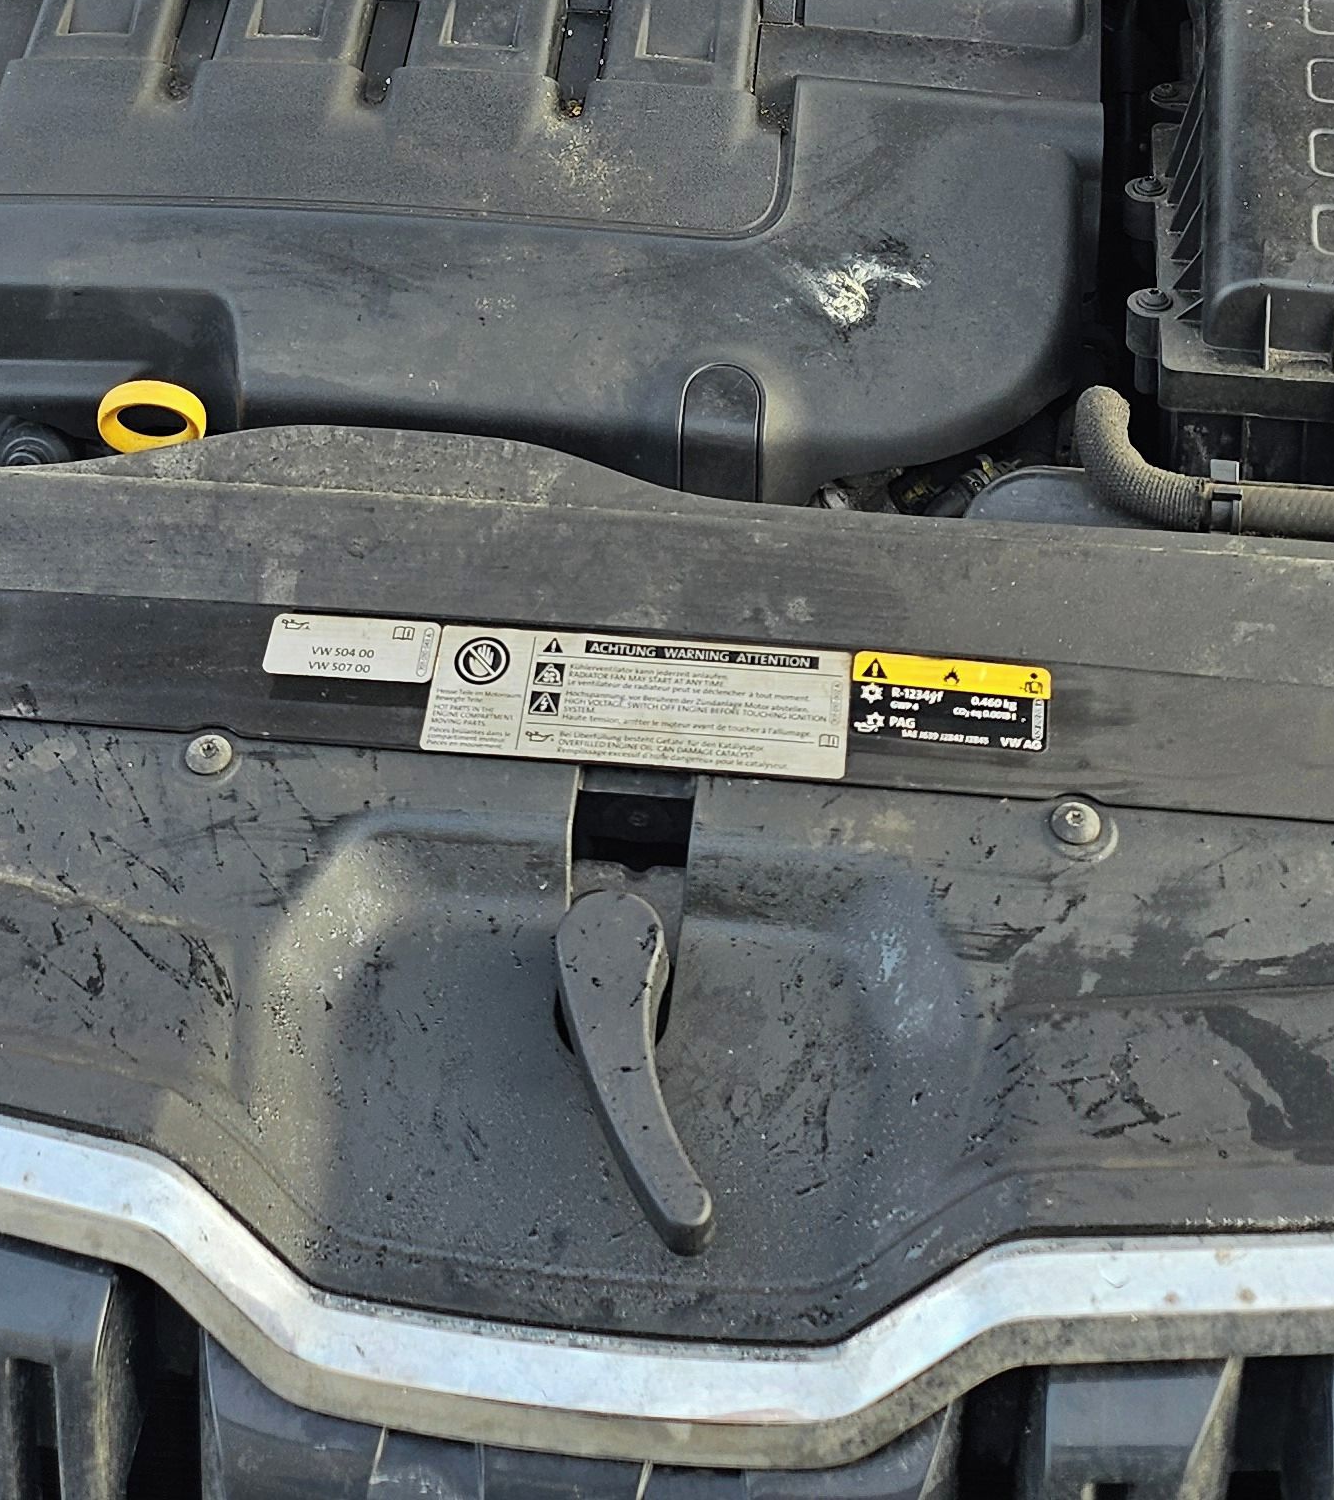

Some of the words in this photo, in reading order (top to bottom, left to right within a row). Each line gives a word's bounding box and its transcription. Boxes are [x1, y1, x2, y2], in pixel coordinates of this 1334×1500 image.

[311, 646, 332, 656] VW
[335, 648, 356, 658] 504
[359, 649, 374, 659] 00
[590, 642, 656, 657] ACHTUNG
[664, 648, 730, 662] WARNING
[736, 652, 811, 668] ATTENTION
[308, 661, 330, 671] VW
[332, 662, 353, 672] 507
[354, 663, 371, 673] 00
[569, 671, 608, 679] RADIATOR
[743, 709, 787, 719] TOUCHING
[788, 713, 827, 722] IGNITION
[889, 715, 916, 728] PAG
[1000, 736, 1023, 748] VW
[1023, 739, 1043, 751] AG
[677, 747, 713, 756] DAMAGE
